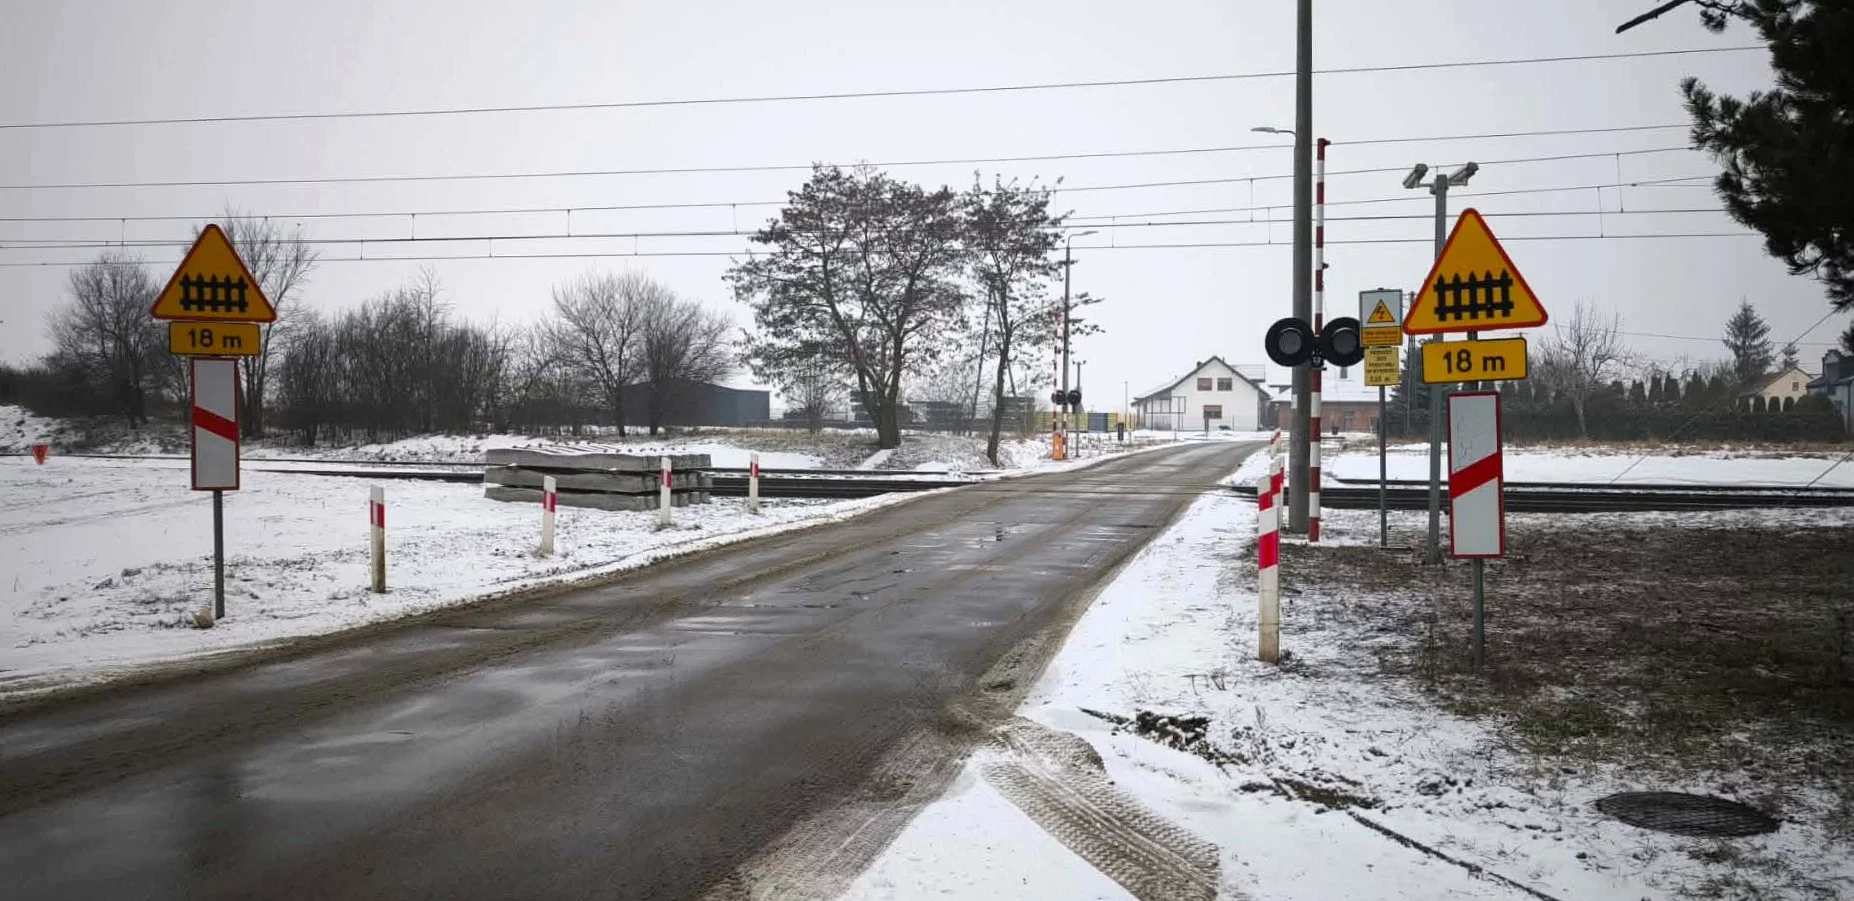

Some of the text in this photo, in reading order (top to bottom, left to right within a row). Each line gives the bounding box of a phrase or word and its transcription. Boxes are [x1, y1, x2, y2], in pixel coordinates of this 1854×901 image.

[188, 329, 242, 349] 18 m
[1443, 348, 1505, 374] 18 m
